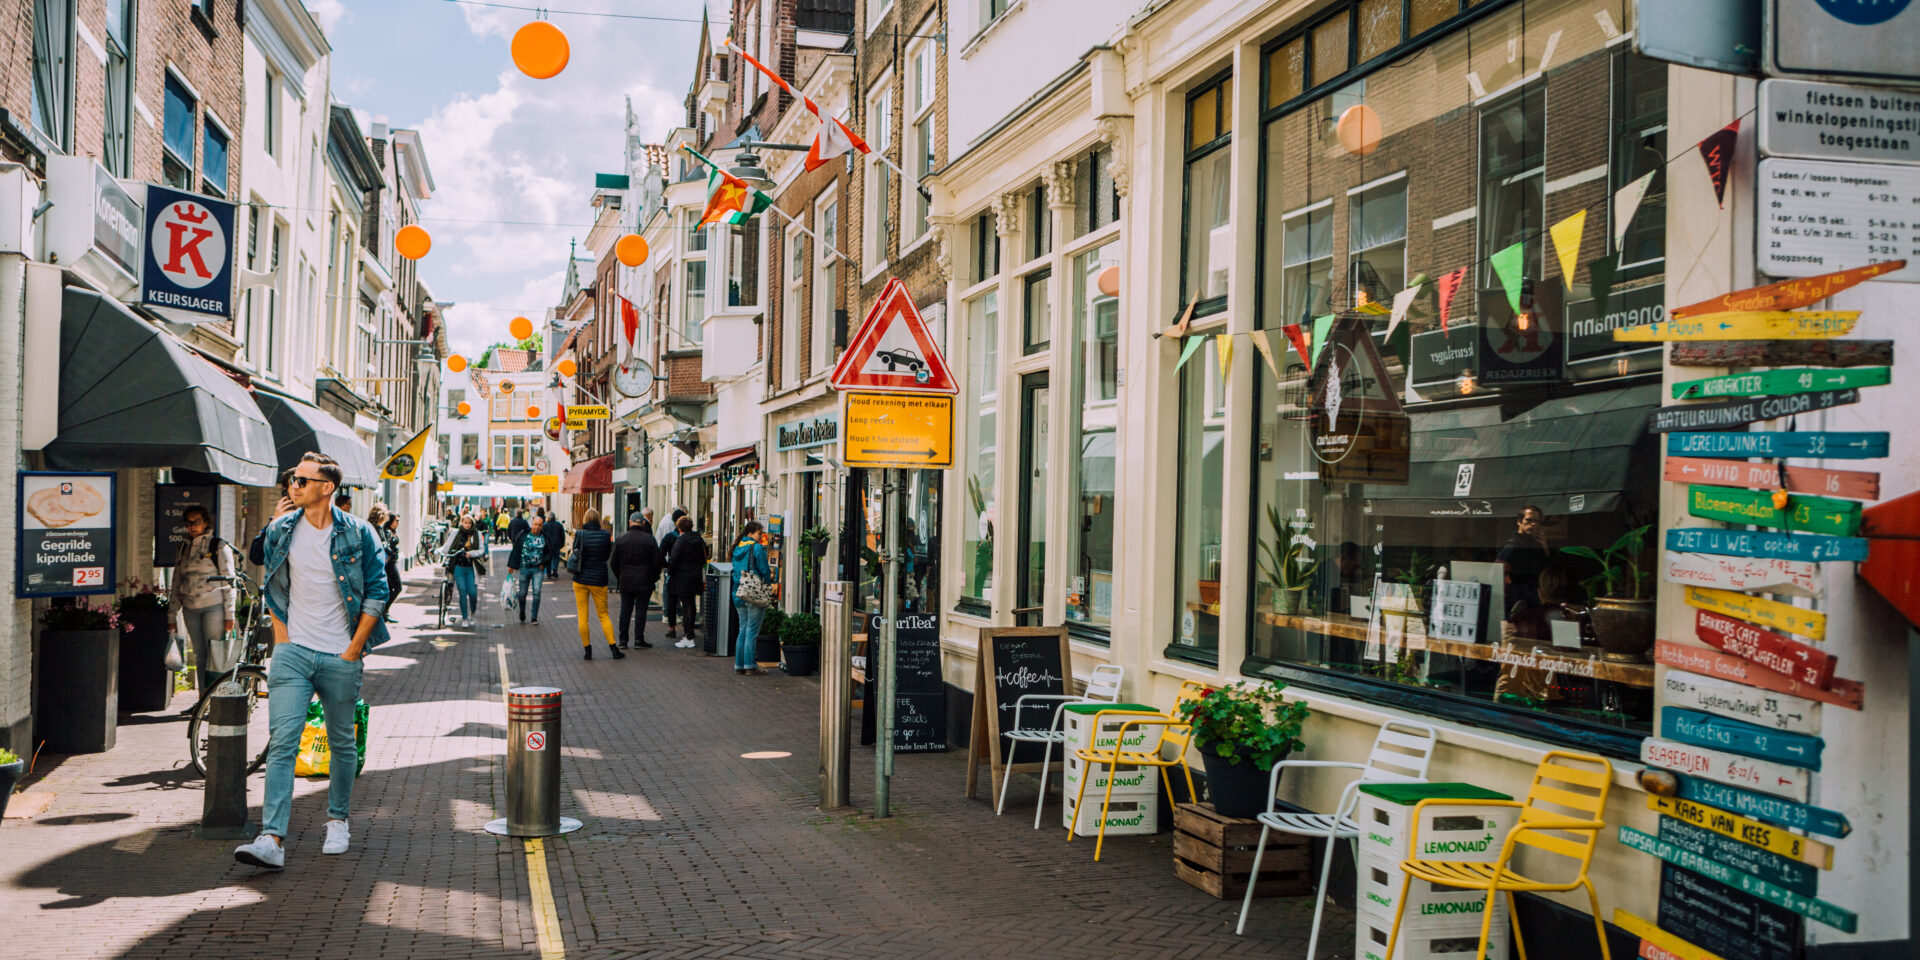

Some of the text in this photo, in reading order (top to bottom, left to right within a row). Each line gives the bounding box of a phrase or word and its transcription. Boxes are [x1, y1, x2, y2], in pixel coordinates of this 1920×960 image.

[1806, 91, 1864, 107] fietsen
[1819, 131, 1910, 151] toegestaan
[1771, 171, 1799, 180] Laden
[1809, 173, 1837, 182] lossen
[1771, 201, 1782, 209] do
[96, 184, 139, 250] Konermann
[163, 221, 213, 279] K
[1770, 253, 1823, 265] koopzondag
[148, 290, 224, 312] KEURSLAGER
[1703, 375, 1763, 396] KARAKTER
[850, 397, 871, 405] Houd
[872, 399, 906, 408] rekening
[908, 399, 923, 407] met
[1656, 404, 1756, 428] NATUURWINKEL
[1760, 394, 1811, 418] GOUDA
[568, 408, 608, 416] PYRAMYDE
[850, 416, 895, 425] Loop rechts
[1681, 434, 1827, 454] WERELDWINKEL 38
[1702, 462, 1739, 481] VIVID
[1825, 474, 1840, 493] 16
[41, 539, 92, 553] Gegrilde
[1677, 531, 1703, 548] ZIET
[1710, 533, 1719, 549] U
[1726, 534, 1753, 553] WEL
[1825, 540, 1840, 557] 26
[36, 551, 96, 566] kiprollade
[1440, 621, 1463, 636] OPEN
[1699, 612, 1761, 648] BAKKERS CAFE
[1488, 641, 1537, 678] Biologisch
[1661, 645, 1712, 673] Hobbyshop
[1722, 635, 1818, 685] SIROOPWAFELEN 32
[1007, 666, 1041, 689] coffee
[909, 704, 917, 715] &
[1764, 699, 1778, 712] 33
[901, 714, 928, 724] snacks
[903, 729, 914, 741] go
[1754, 736, 1768, 751] 42
[913, 742, 928, 750] Iced
[929, 742, 946, 750] Teas
[1793, 807, 1808, 825] 39
[1674, 800, 1800, 855] KAAS VAN KEES 8
[1619, 827, 1673, 859] KAPSALON
